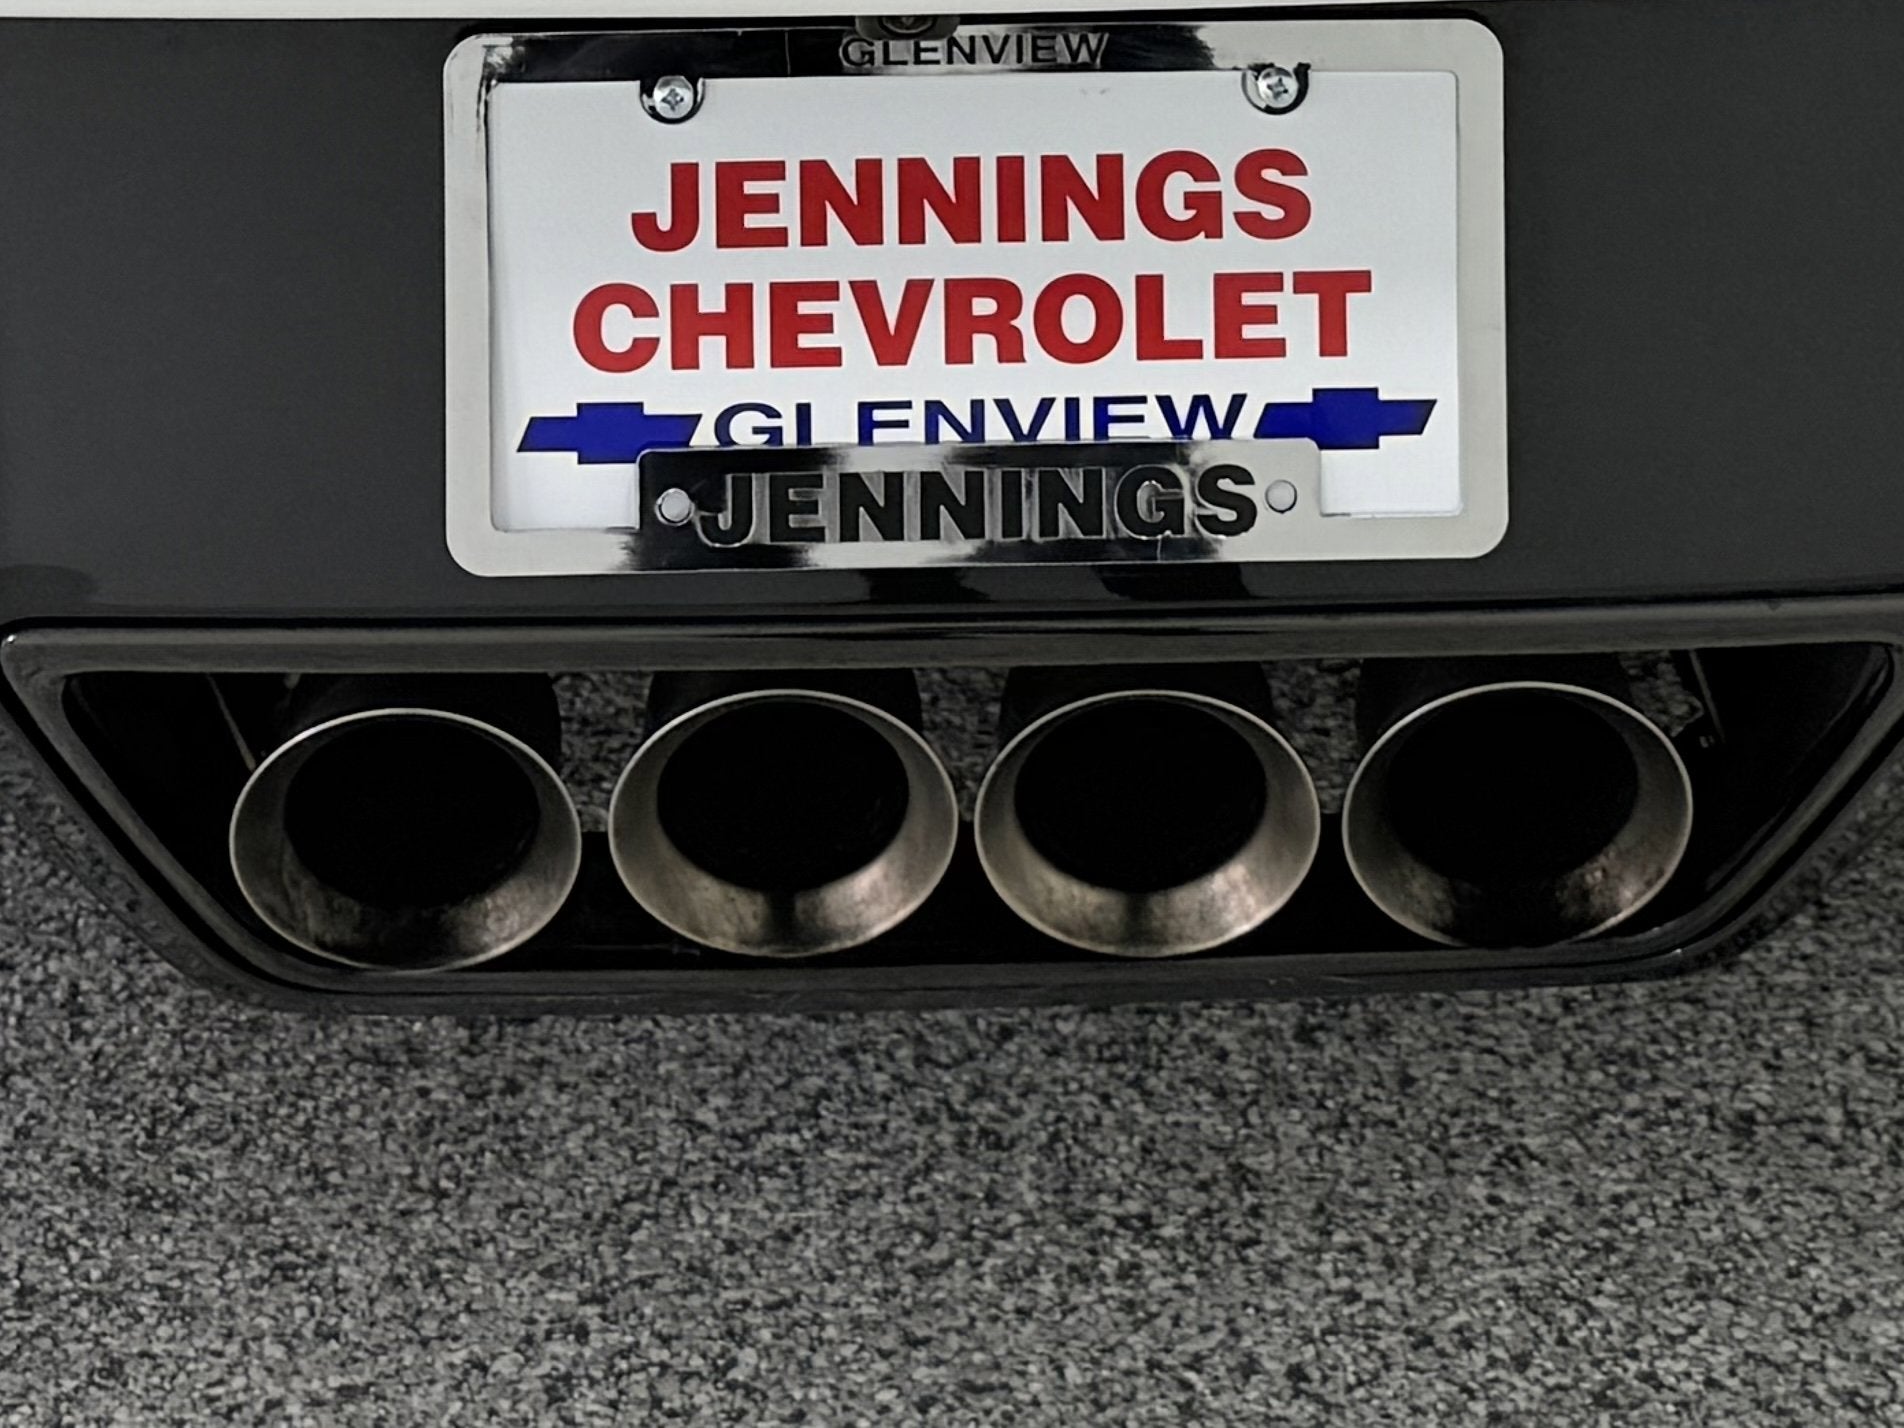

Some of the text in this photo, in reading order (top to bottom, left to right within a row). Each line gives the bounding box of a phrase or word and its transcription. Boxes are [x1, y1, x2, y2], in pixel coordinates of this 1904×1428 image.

[840, 32, 1108, 67] GLENVIEW
[631, 148, 1312, 252] JENNINGS
[573, 269, 1372, 372] CHEVROLET
[696, 463, 1259, 547] JENNINGS
